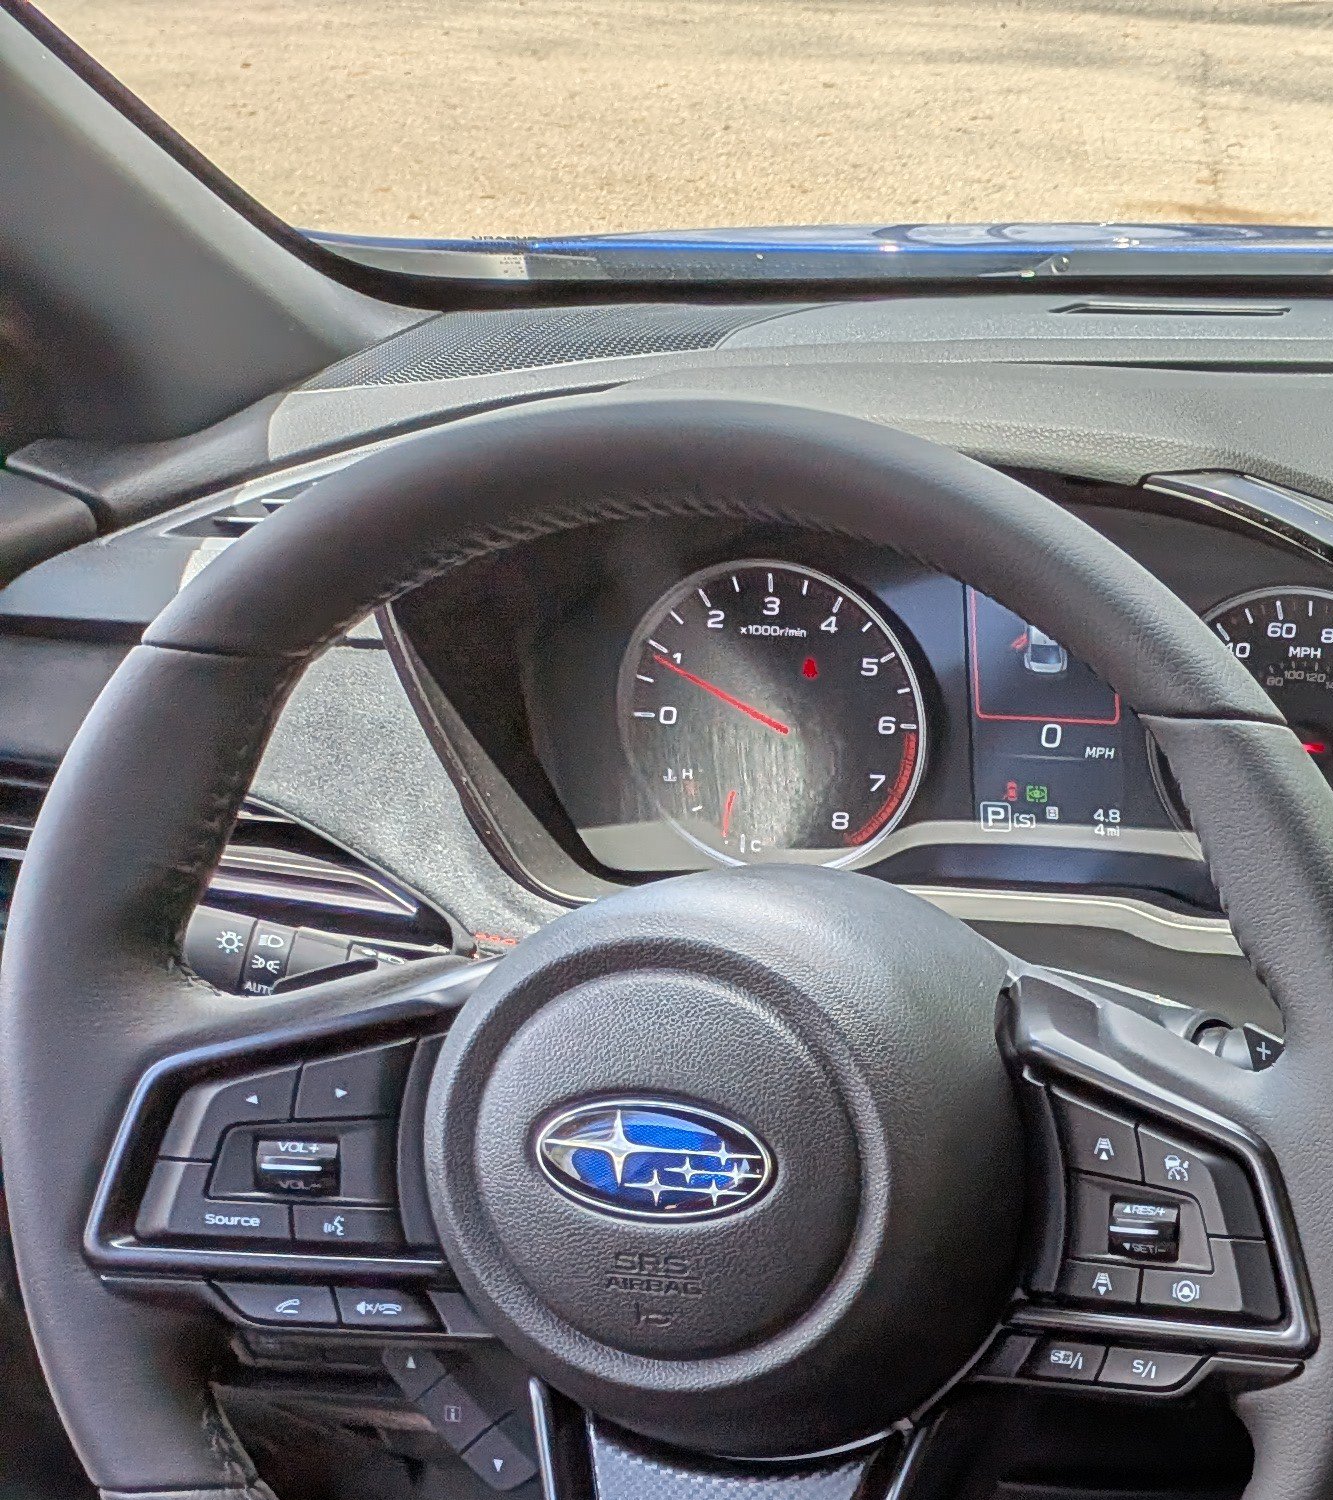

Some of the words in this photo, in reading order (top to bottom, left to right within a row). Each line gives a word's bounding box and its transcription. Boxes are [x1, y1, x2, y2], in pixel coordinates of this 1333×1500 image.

[763, 596, 781, 616] 3
[707, 610, 724, 628] 2
[821, 616, 838, 634] 4
[1267, 623, 1296, 639] 60
[673, 652, 681, 664] 1
[1288, 646, 1321, 659] MPH
[861, 657, 878, 676] 5
[659, 707, 677, 724] 0
[878, 716, 896, 734] 6
[1041, 724, 1062, 748] 0
[1085, 747, 1115, 758] MPH
[682, 770, 693, 779] H
[870, 775, 885, 791] 7
[831, 812, 849, 829] 8
[987, 807, 1004, 826] P
[1093, 809, 1120, 823] 4.8
[751, 841, 761, 851] C
[205, 1214, 260, 1226] Source
[615, 1252, 688, 1274] SRS
